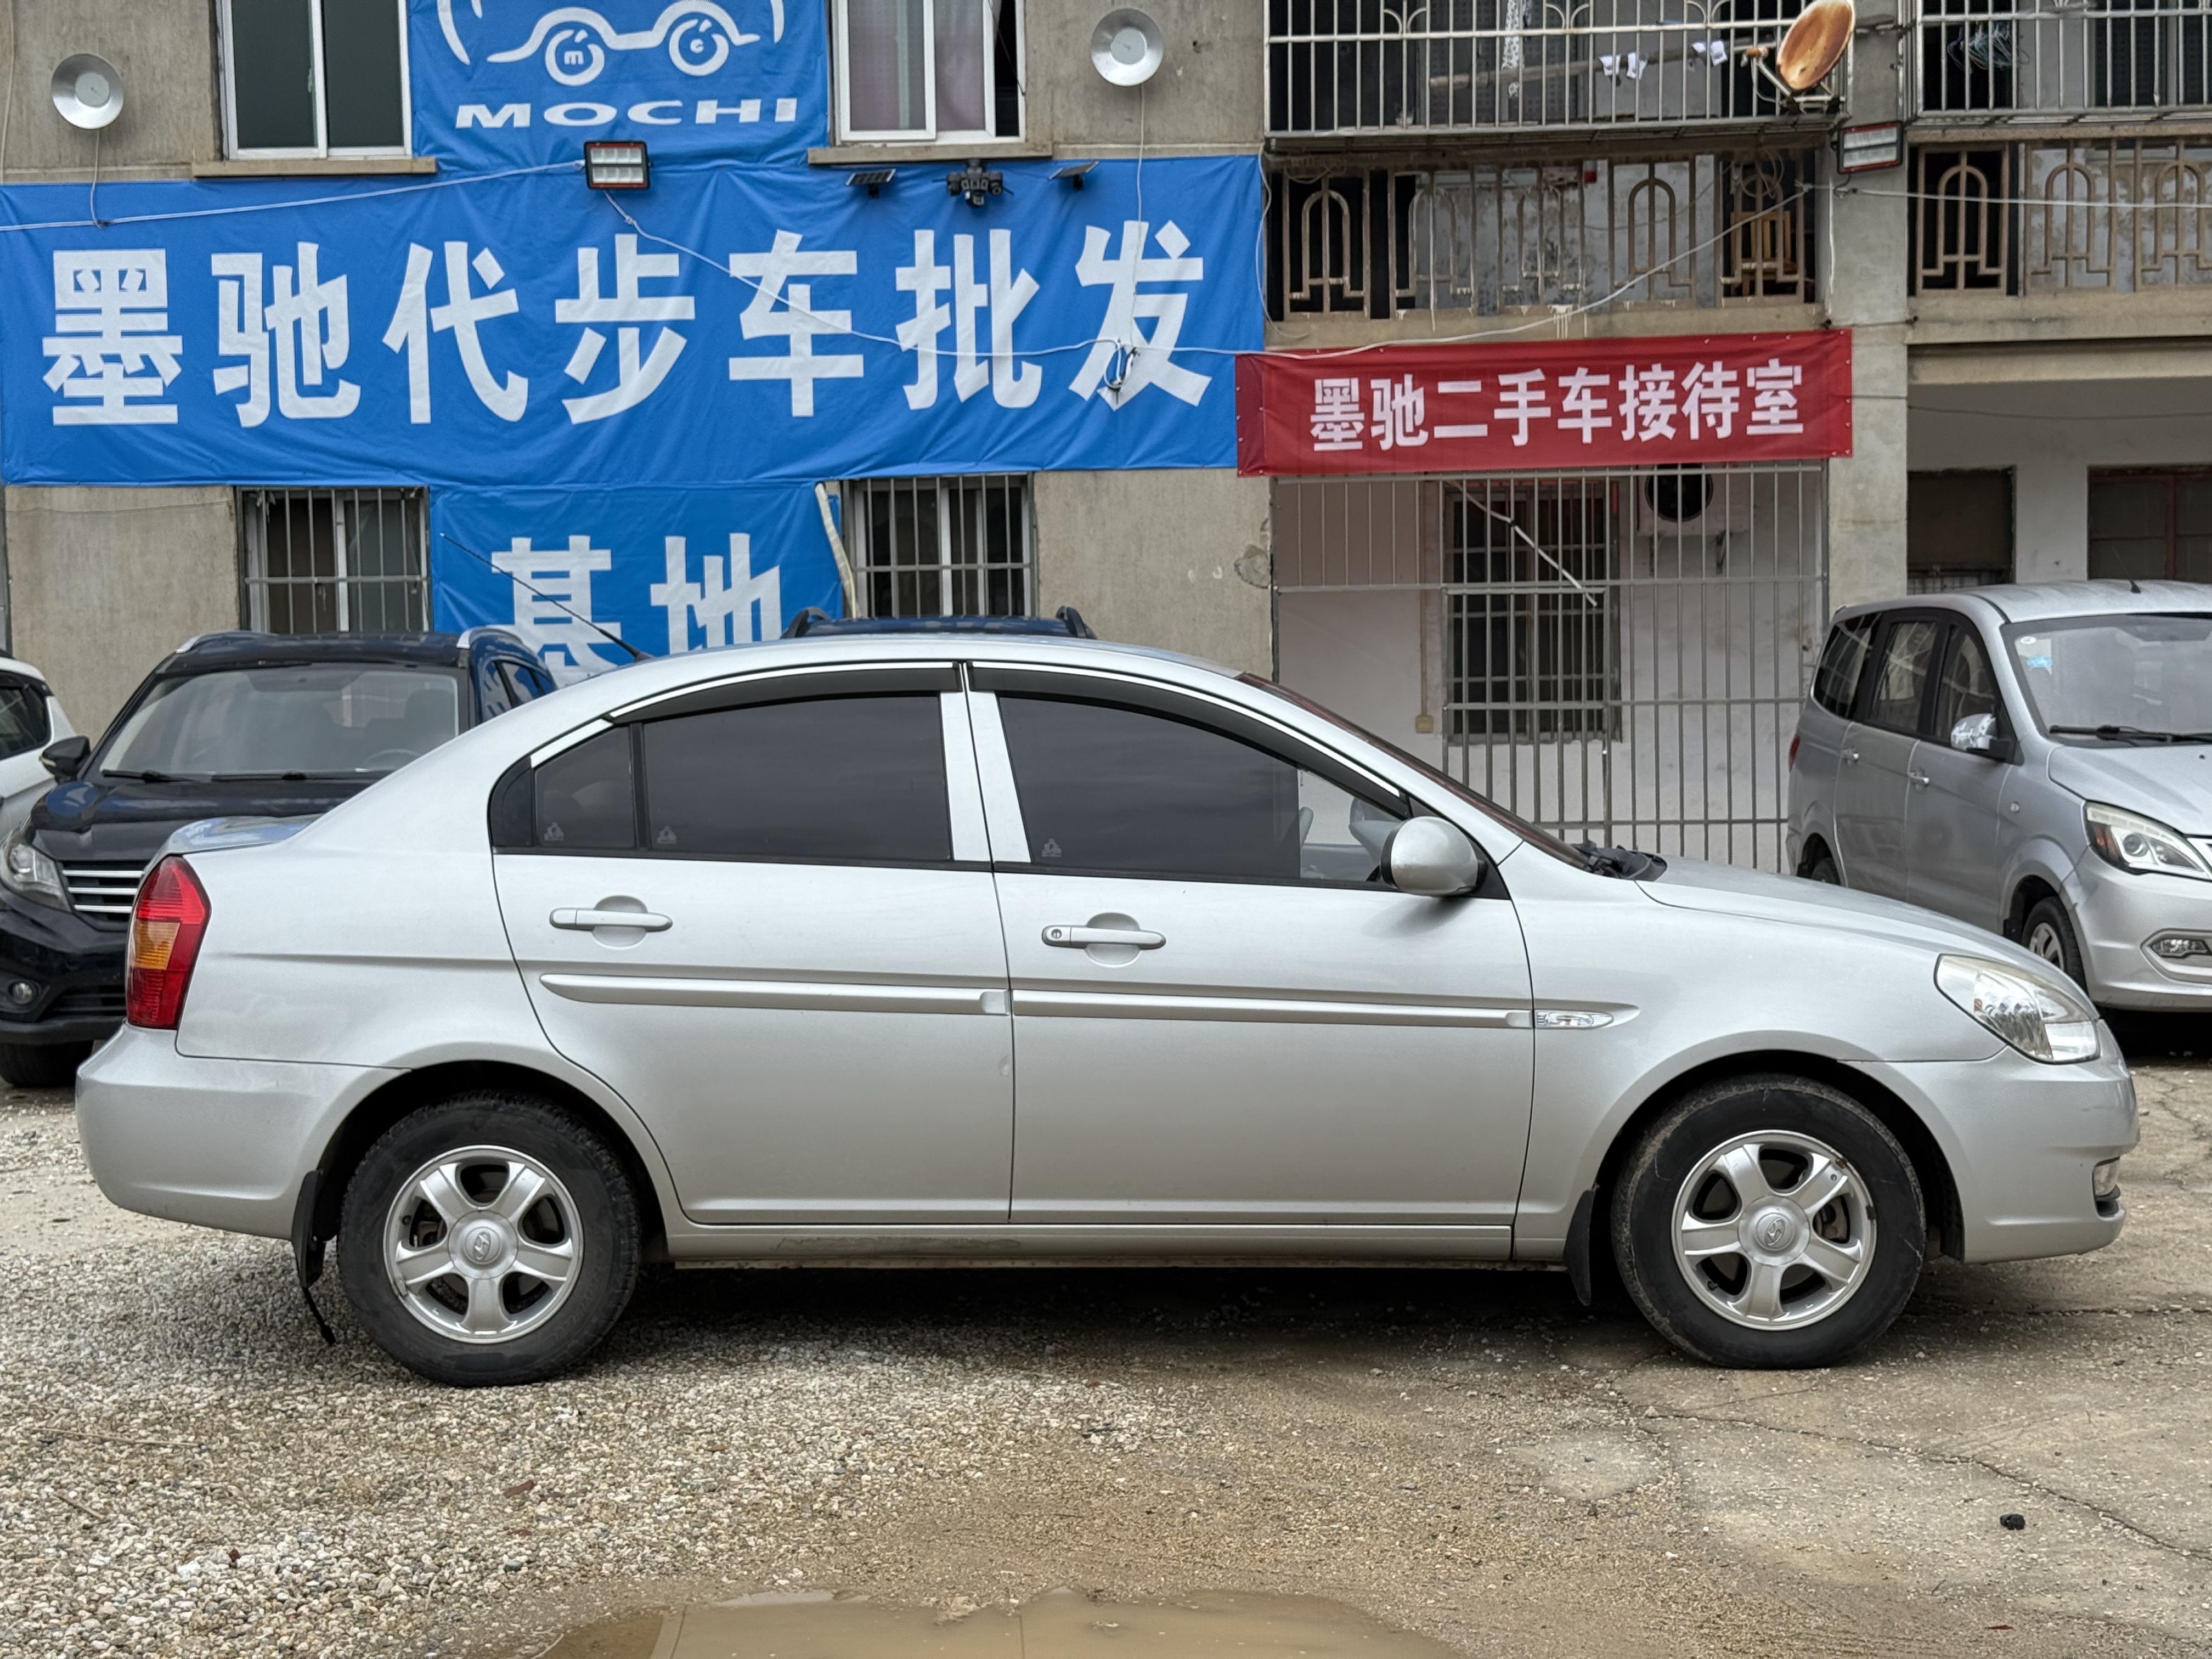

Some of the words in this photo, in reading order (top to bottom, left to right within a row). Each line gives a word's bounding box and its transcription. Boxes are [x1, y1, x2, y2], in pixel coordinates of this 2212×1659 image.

[456, 98, 797, 128] MOCHI
[42, 221, 1212, 426] 墨驰代步车批发
[1310, 358, 1804, 452] 墨驰二手车接待室
[486, 533, 782, 688] 基地
